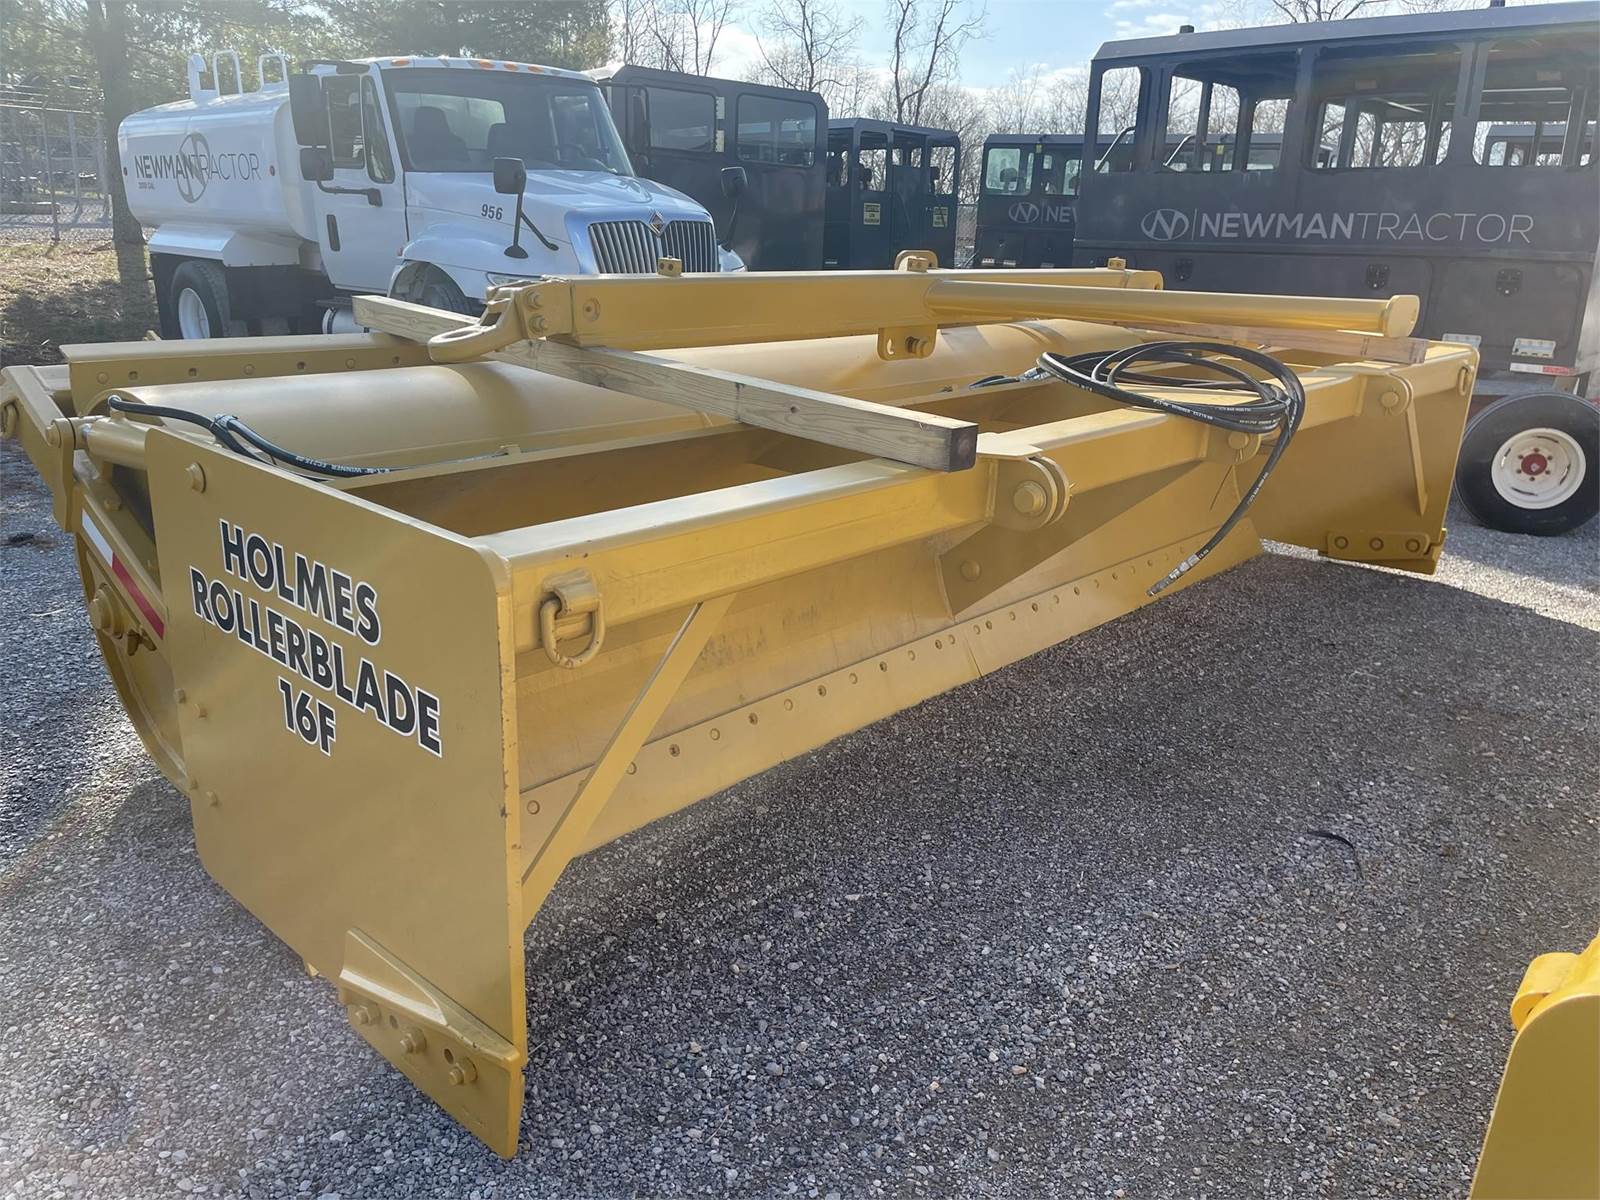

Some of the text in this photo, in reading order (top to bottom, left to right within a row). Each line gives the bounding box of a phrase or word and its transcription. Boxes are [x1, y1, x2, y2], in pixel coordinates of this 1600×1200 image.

[481, 203, 503, 220] 956
[219, 518, 381, 646] HOLMES
[189, 565, 442, 758] ROLLERBLADE
[278, 675, 336, 757] 16F
